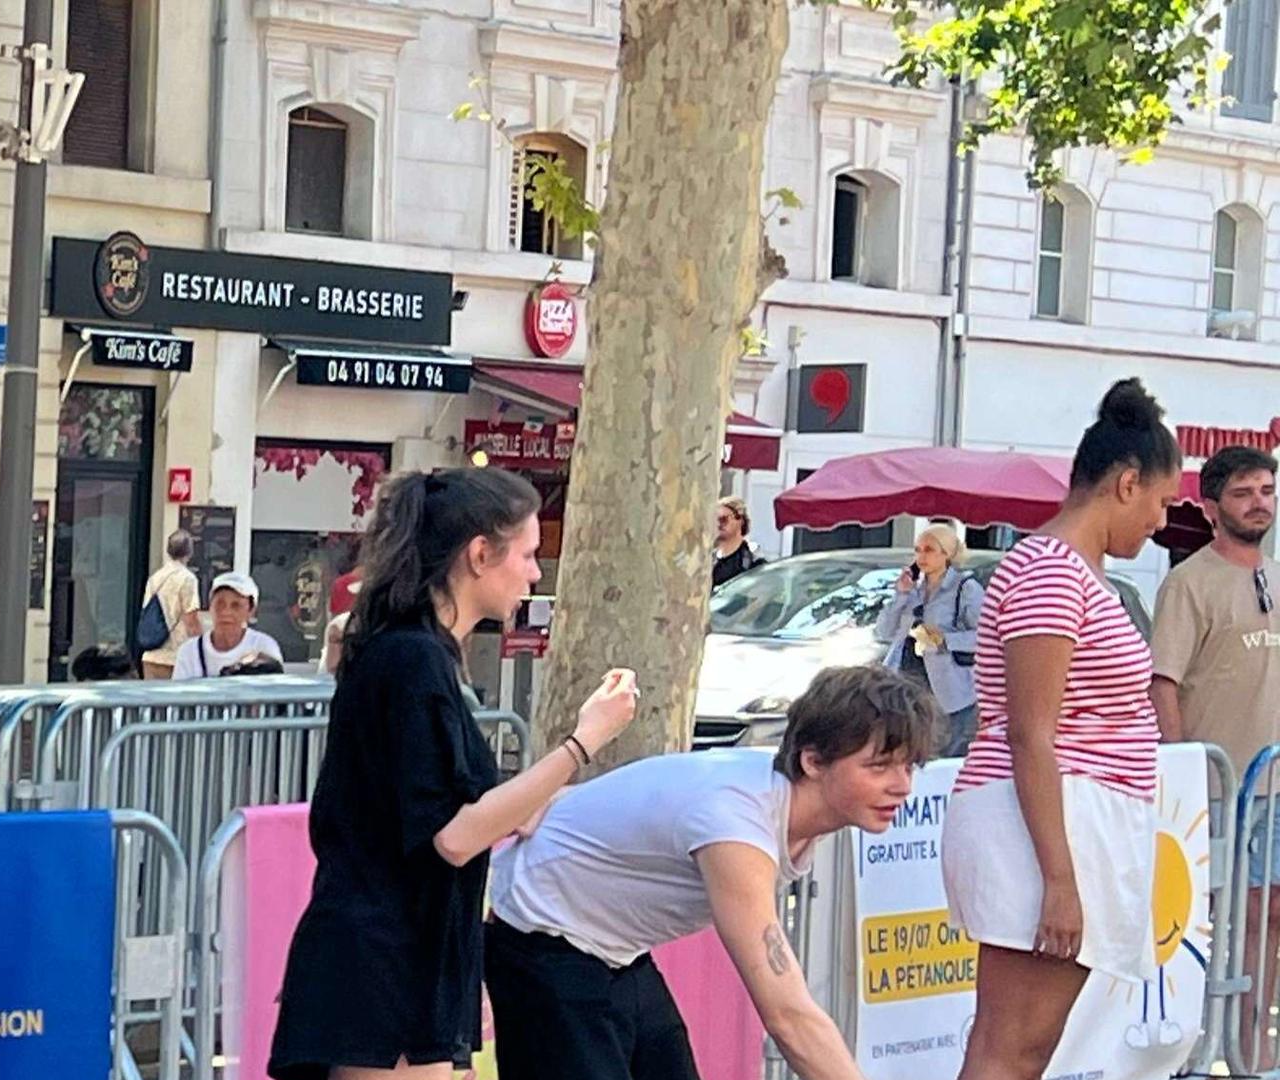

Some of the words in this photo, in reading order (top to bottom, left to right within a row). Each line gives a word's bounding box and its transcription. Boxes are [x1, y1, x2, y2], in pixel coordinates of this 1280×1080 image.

[162, 271, 295, 307] RESTAURANT
[317, 286, 423, 319] BRASSERIE
[105, 338, 145, 361] Kim's
[148, 340, 182, 368] Café
[328, 360, 348, 382] 04
[354, 360, 370, 384] 91
[375, 362, 395, 385] 04
[401, 363, 420, 386] 07
[425, 364, 443, 387] 94
[867, 841, 927, 864] GRATUITE
[868, 929, 888, 954] LE
[869, 967, 891, 994] LA
[896, 956, 976, 990] PÉTANQUE
